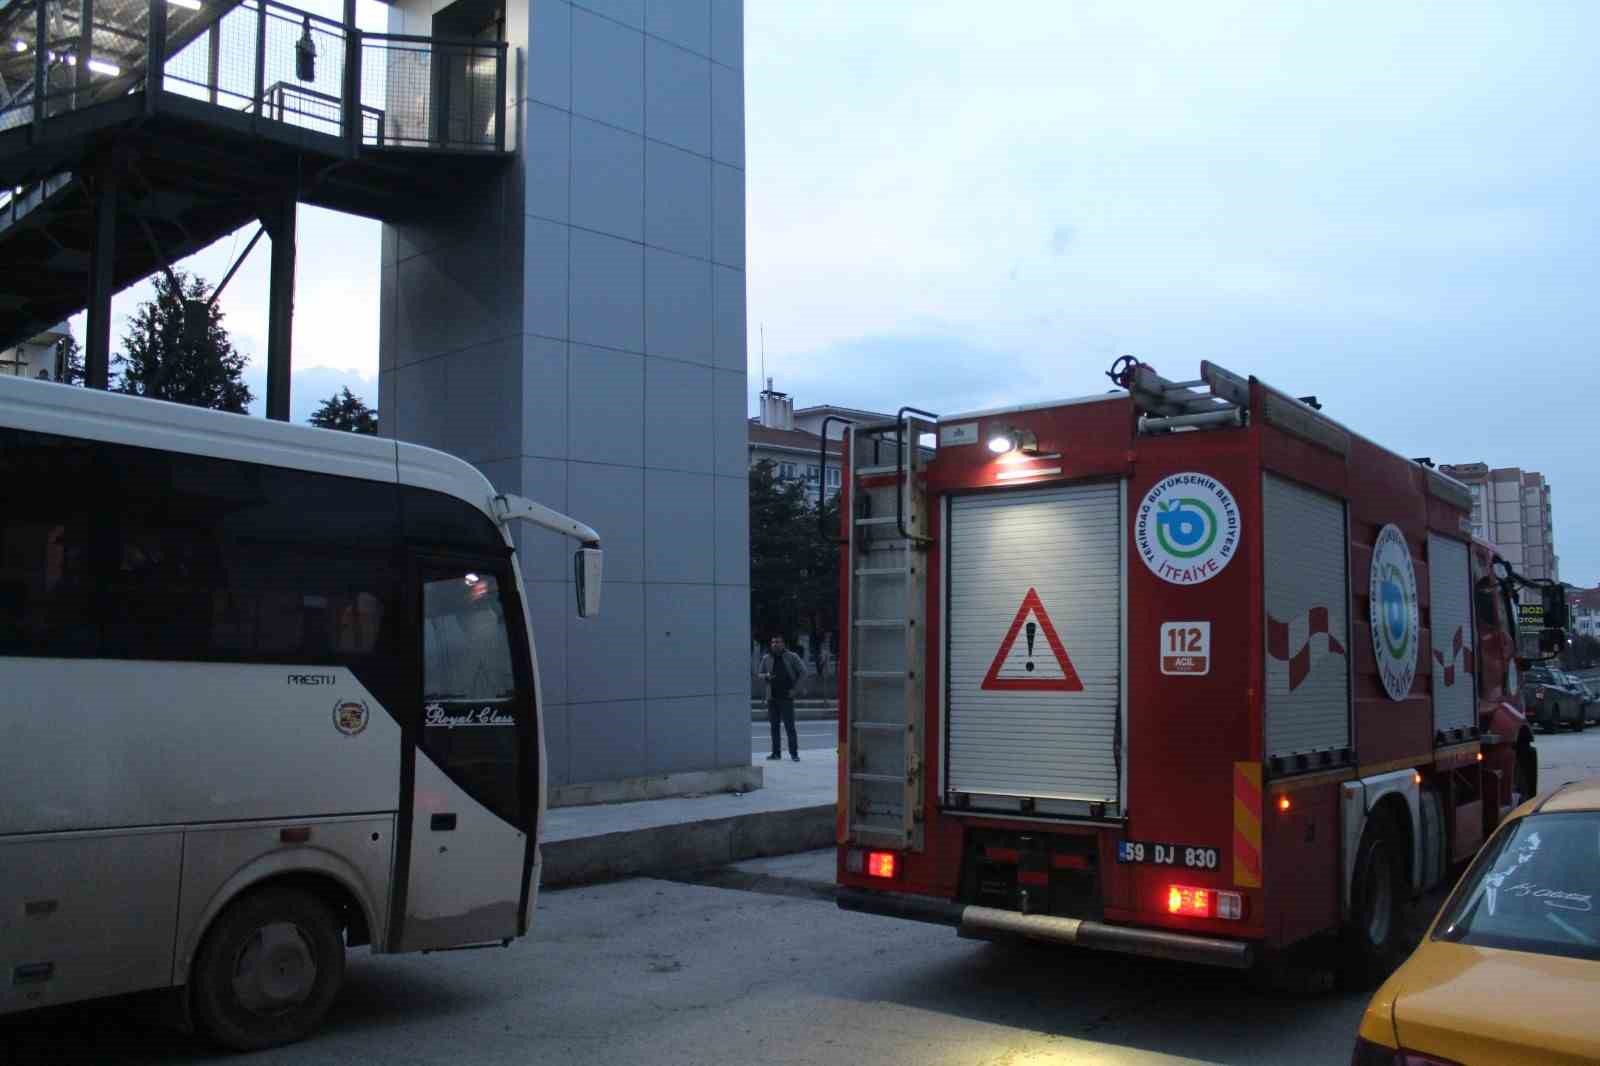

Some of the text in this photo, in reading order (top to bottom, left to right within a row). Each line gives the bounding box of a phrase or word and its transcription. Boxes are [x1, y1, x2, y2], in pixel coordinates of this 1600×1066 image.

[1148, 475, 1217, 504] BÜYÜKŞEHİR
[1158, 558, 1219, 582] İTFAİYE
[1167, 627, 1203, 652] 112
[1125, 842, 1217, 869] 59 DJ 830
